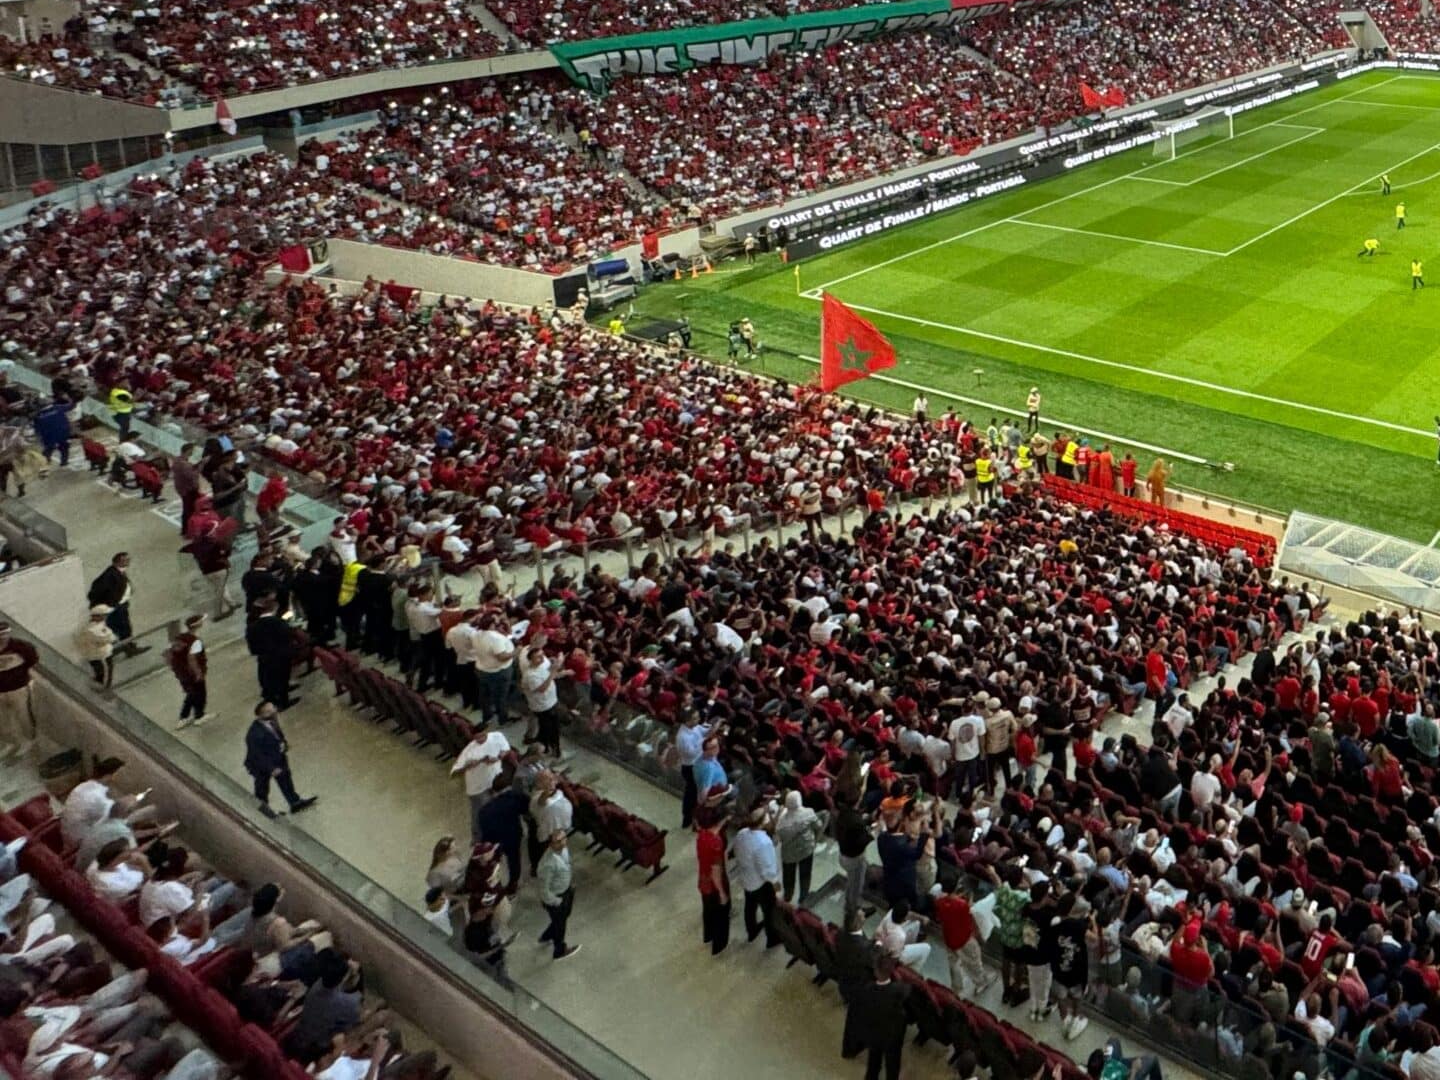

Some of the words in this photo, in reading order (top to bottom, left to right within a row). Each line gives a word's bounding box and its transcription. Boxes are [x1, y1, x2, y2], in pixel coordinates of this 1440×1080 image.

[768, 210, 812, 229] QUART
[814, 205, 833, 216] DE
[832, 192, 876, 211] FINALE
[883, 179, 922, 196] MAROC
[928, 162, 980, 182] PORTUGAL
[819, 226, 864, 248] QUART
[865, 221, 882, 234] DE
[883, 207, 924, 228] FINALE
[932, 193, 969, 211] MAROC
[976, 175, 1026, 197] PORTUGAL
[1304, 936, 1322, 961] 10
